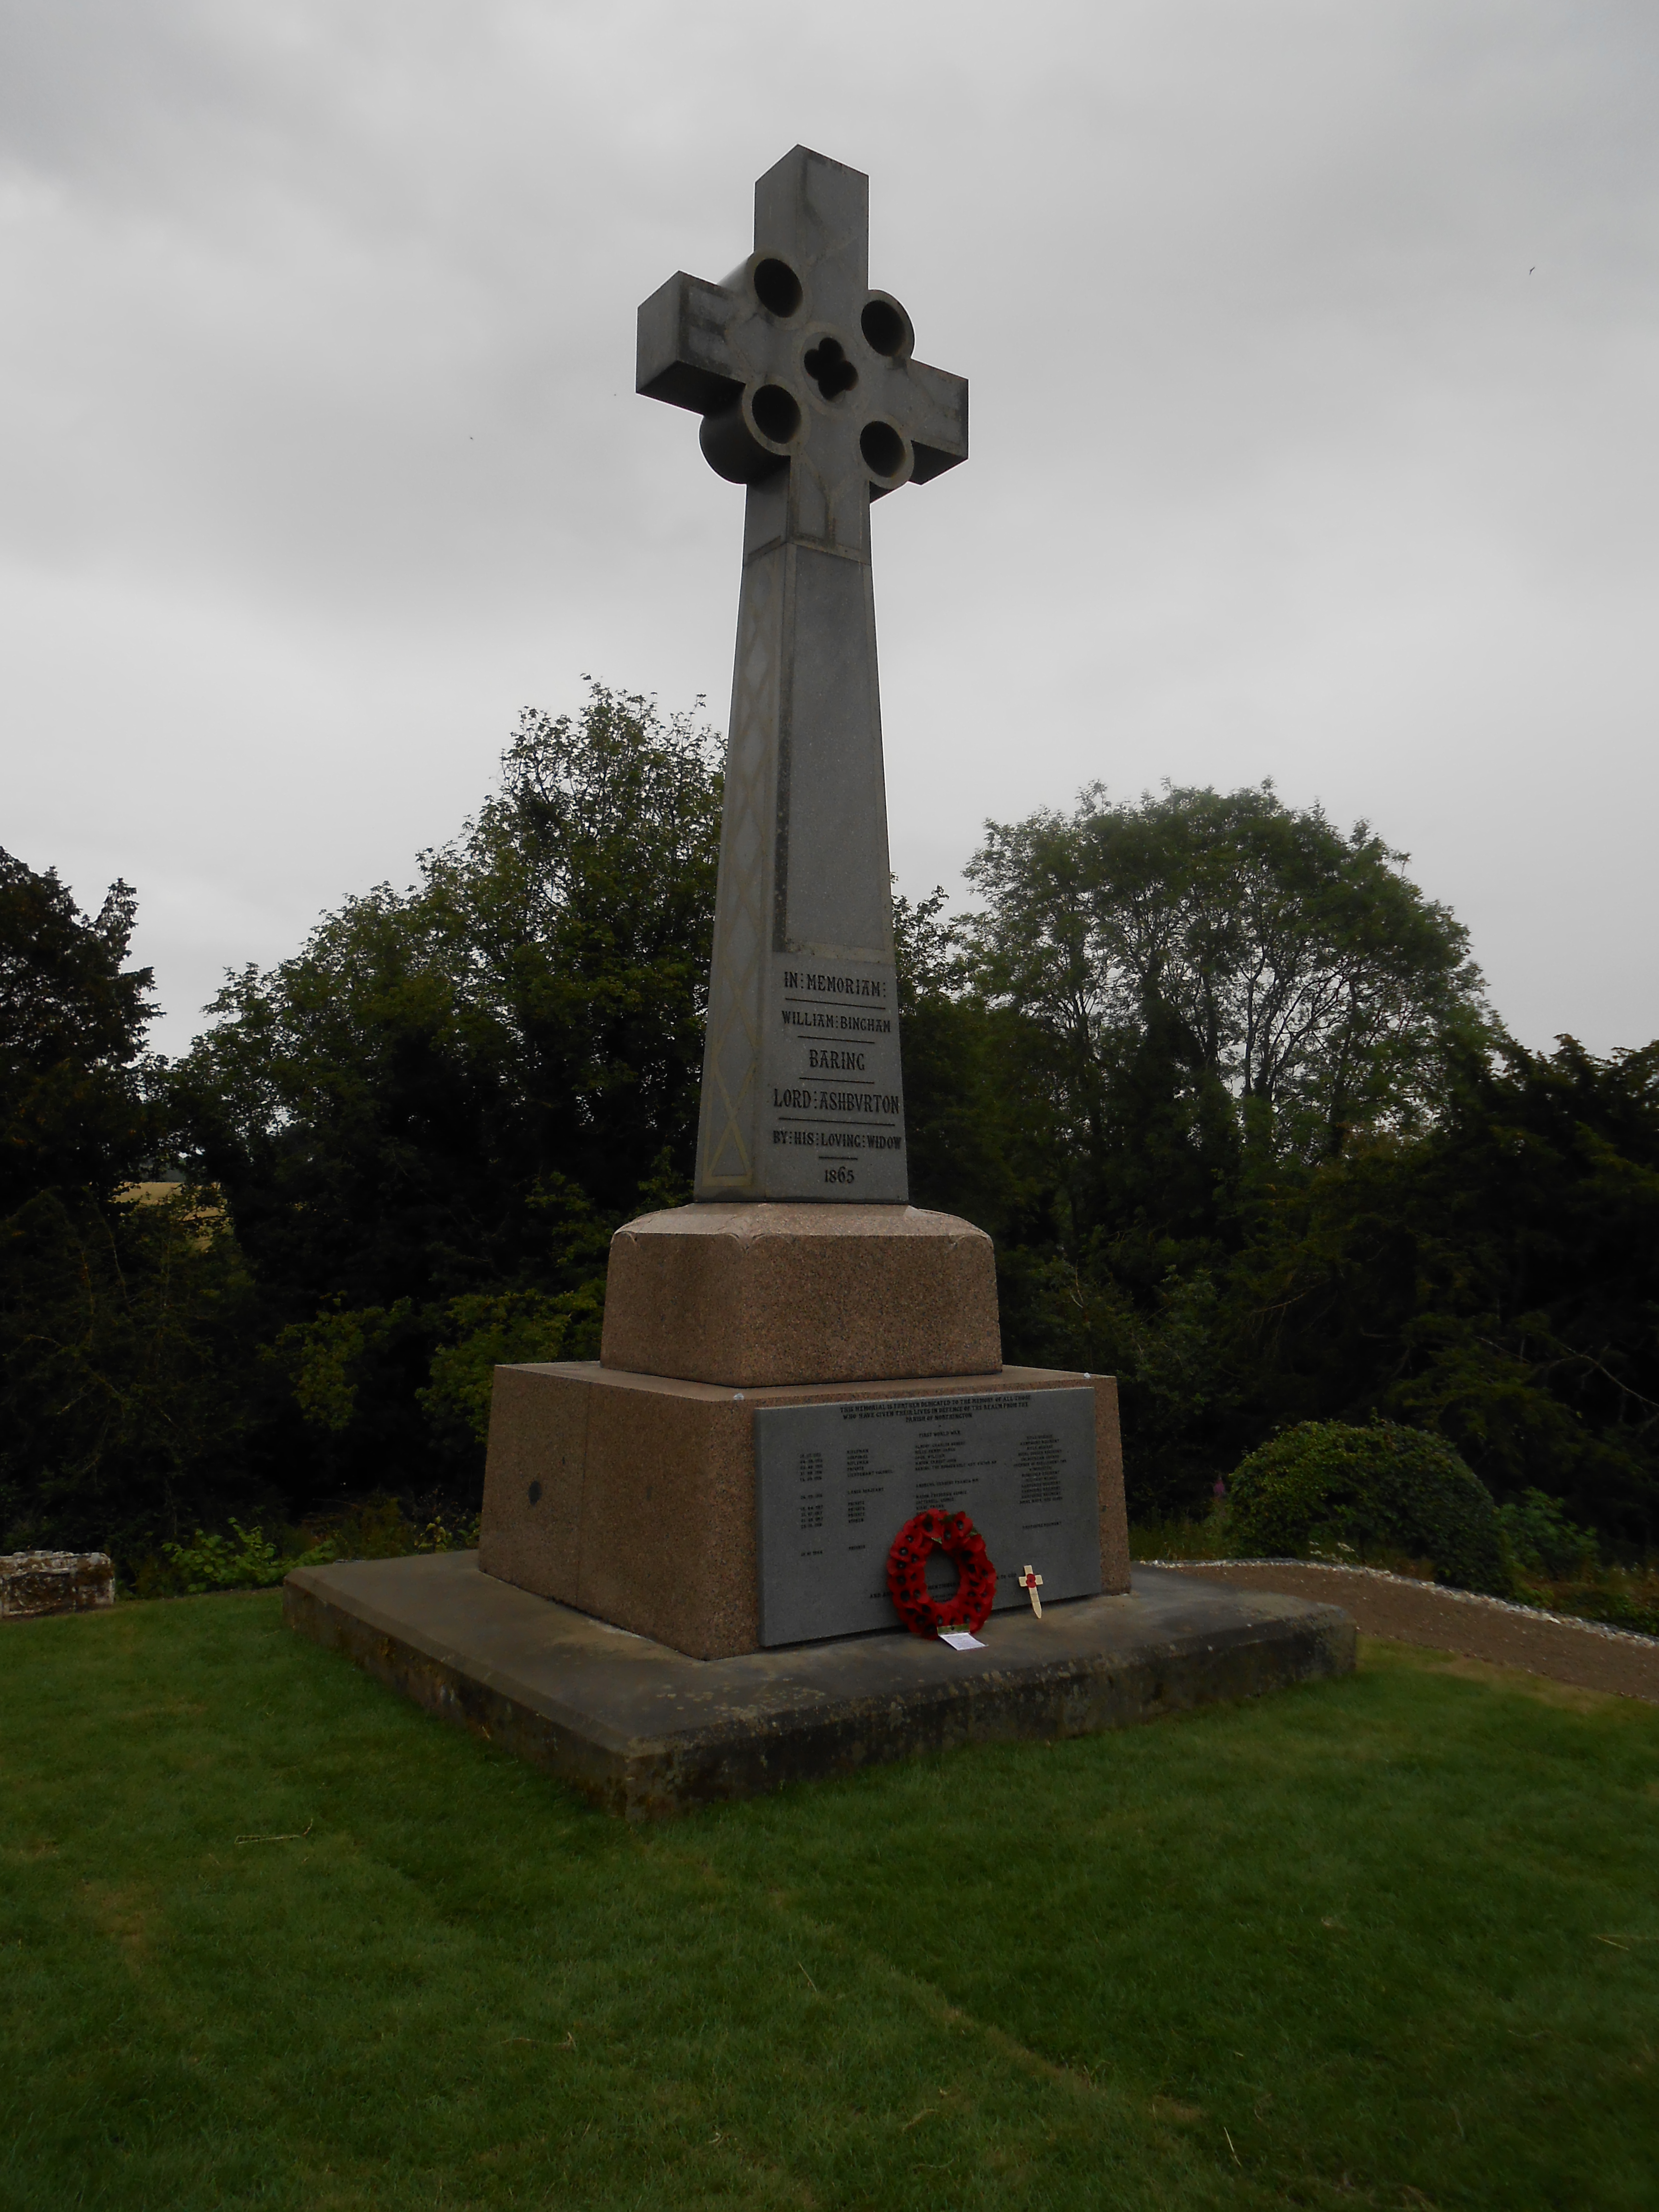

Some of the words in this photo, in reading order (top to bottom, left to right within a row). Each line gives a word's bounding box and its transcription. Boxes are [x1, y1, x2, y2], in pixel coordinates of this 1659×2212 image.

[783, 971, 798, 989] IN
[806, 973, 882, 997] MEMORIAM
[781, 1010, 834, 1028] WILLIAM
[840, 1015, 891, 1033] BINGHAM
[809, 1049, 866, 1071] BARING
[773, 1088, 811, 1109] LORD
[772, 1130, 788, 1145] BY
[794, 1130, 814, 1146] HIS
[821, 1132, 862, 1148] LOVING
[866, 1135, 902, 1149] WIDOW
[824, 1166, 855, 1184] 1865
